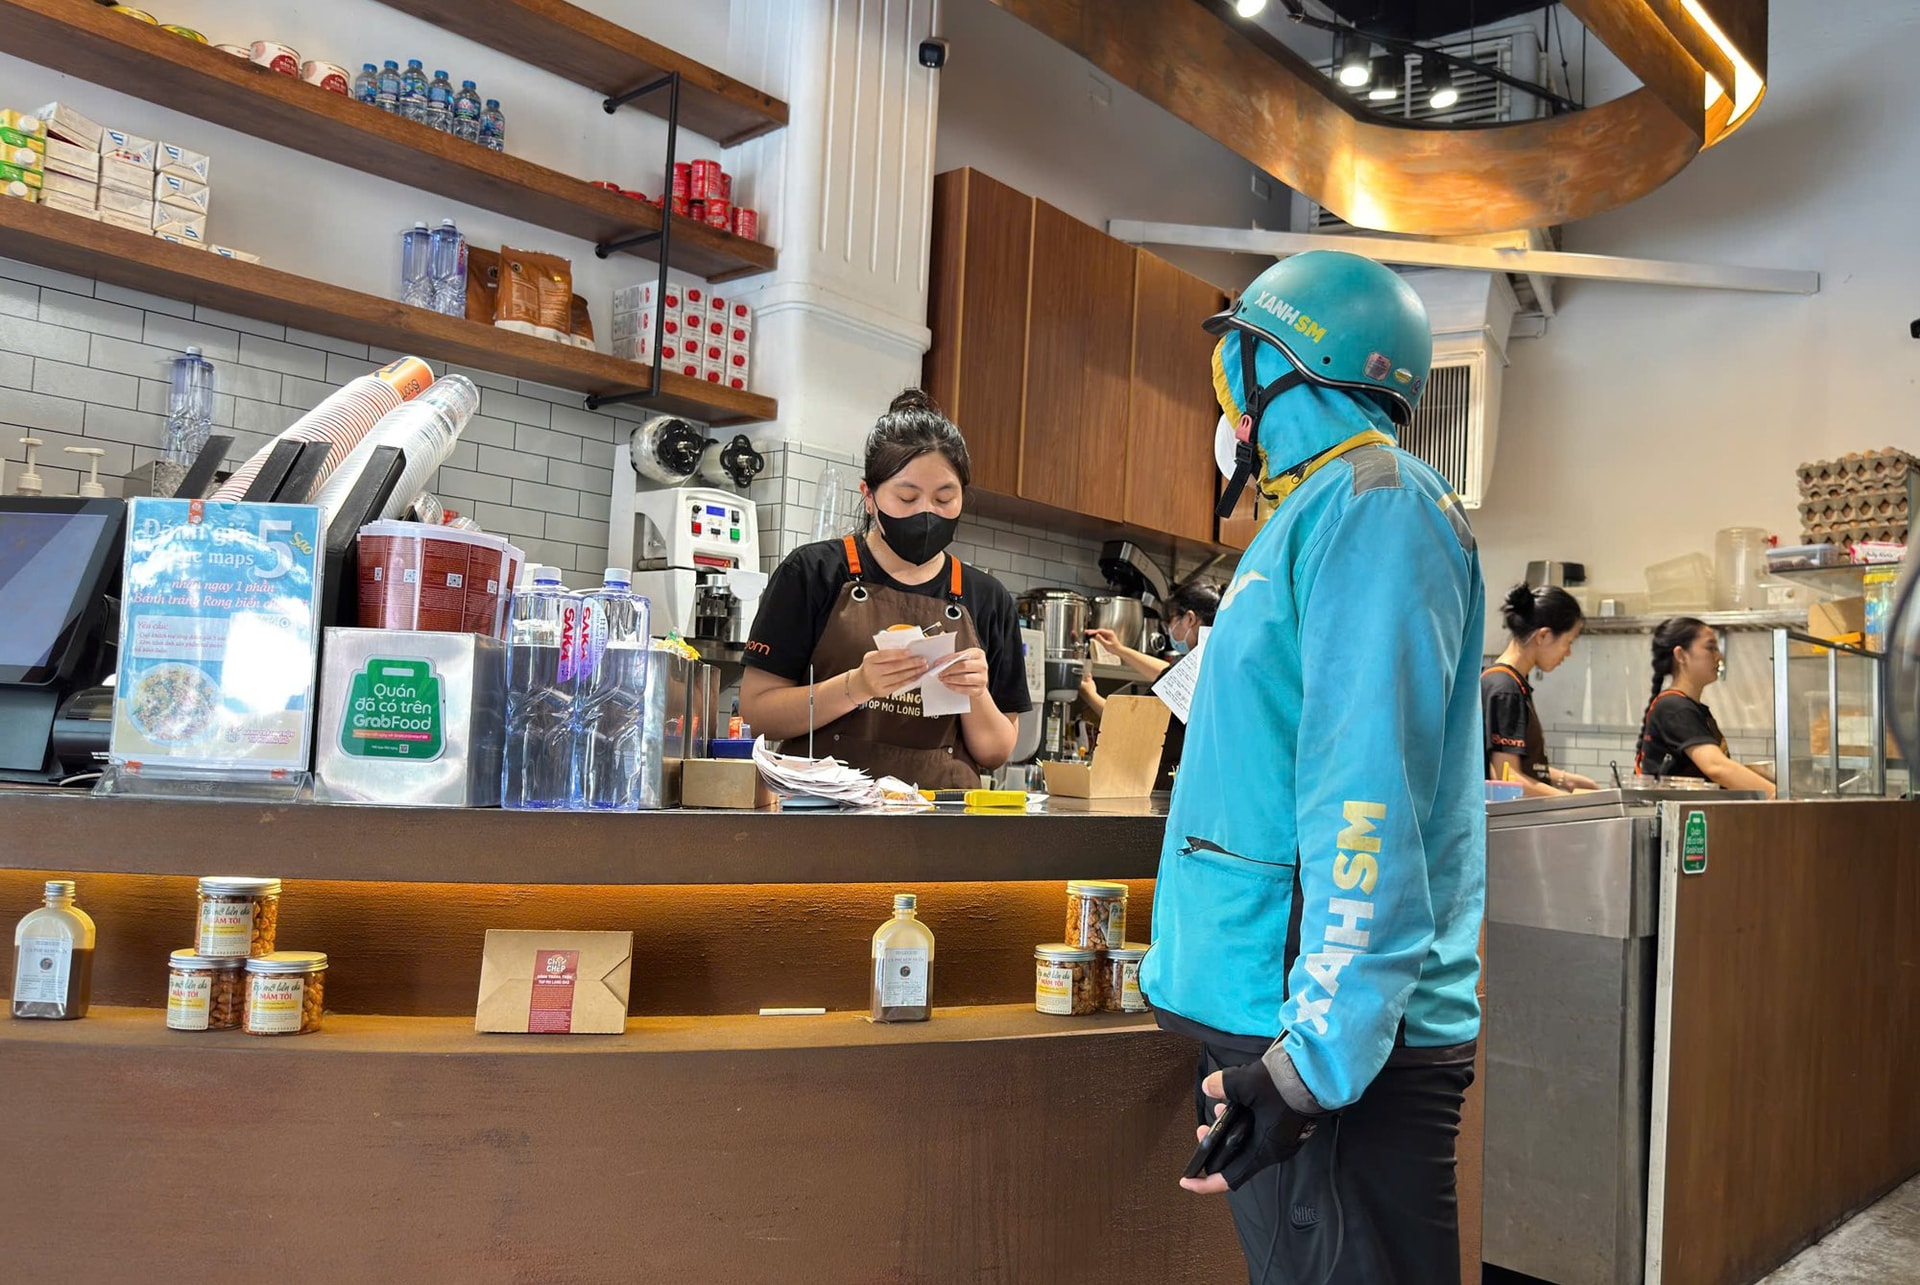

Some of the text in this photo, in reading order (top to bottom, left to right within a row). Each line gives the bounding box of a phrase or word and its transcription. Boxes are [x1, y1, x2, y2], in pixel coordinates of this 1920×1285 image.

[250, 520, 294, 579] 5
[208, 552, 255, 569] maps
[560, 607, 575, 661] SAKA
[374, 683, 416, 699] Quán
[354, 697, 432, 715] đã có trên
[897, 705, 920, 717] LONG
[353, 714, 432, 730] GrabFood
[1293, 1204, 1318, 1222] NIKE
